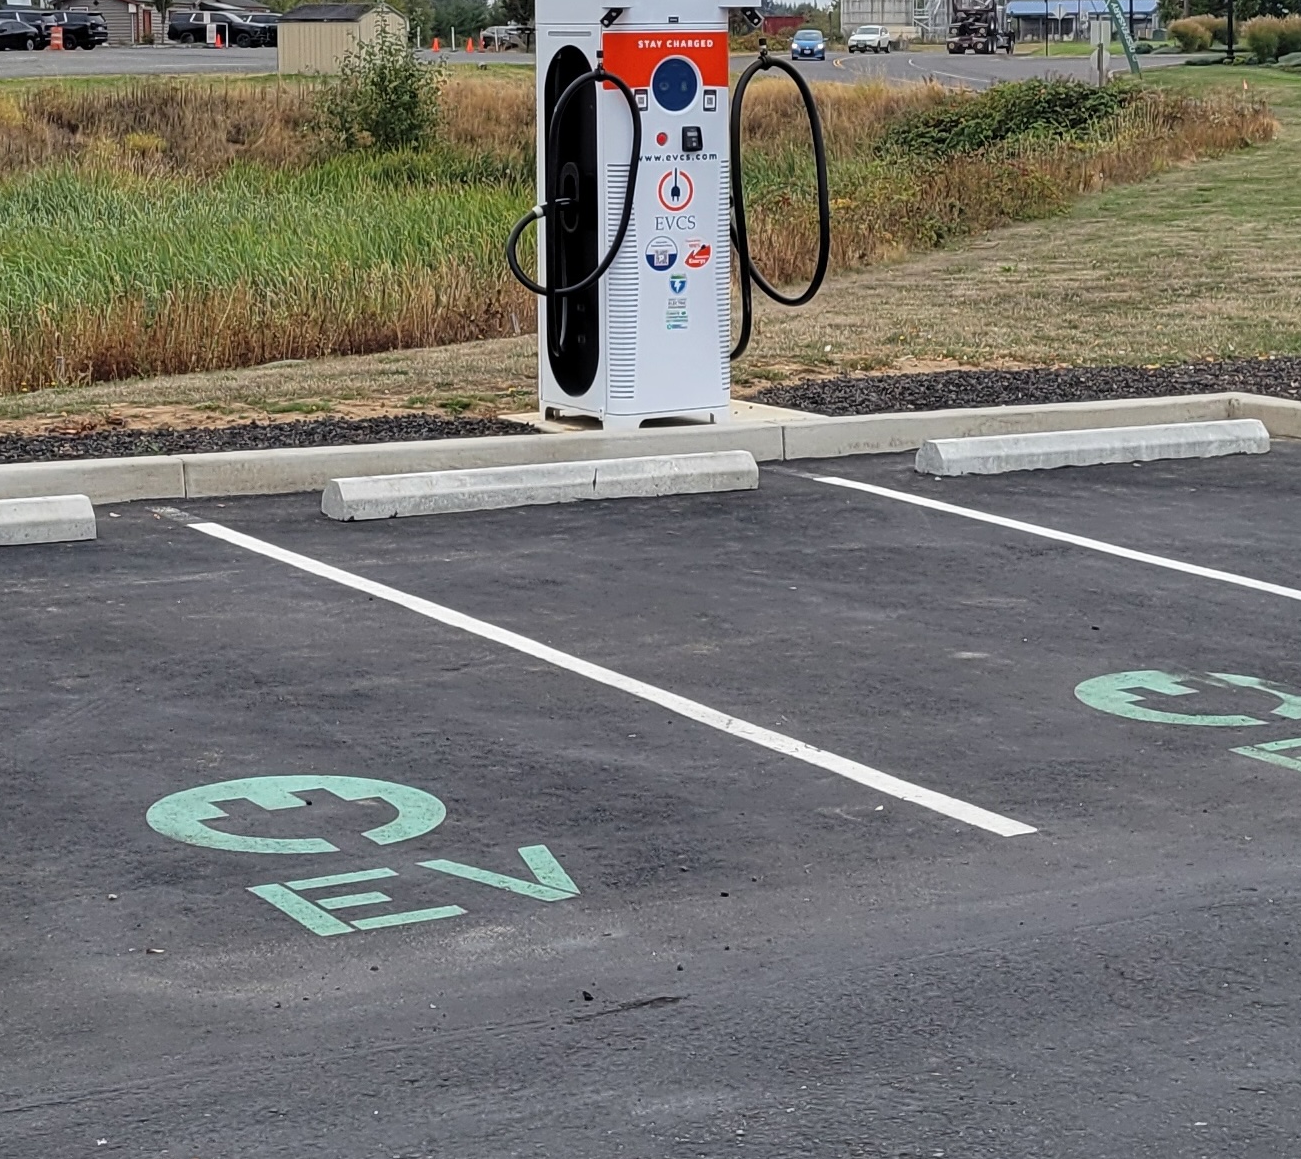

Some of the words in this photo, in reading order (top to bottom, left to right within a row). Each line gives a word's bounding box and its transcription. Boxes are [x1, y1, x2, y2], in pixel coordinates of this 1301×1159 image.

[638, 40, 662, 48] STAY
[666, 39, 714, 48] CHARGED
[655, 215, 696, 231] EVCS
[245, 844, 581, 936] EV
